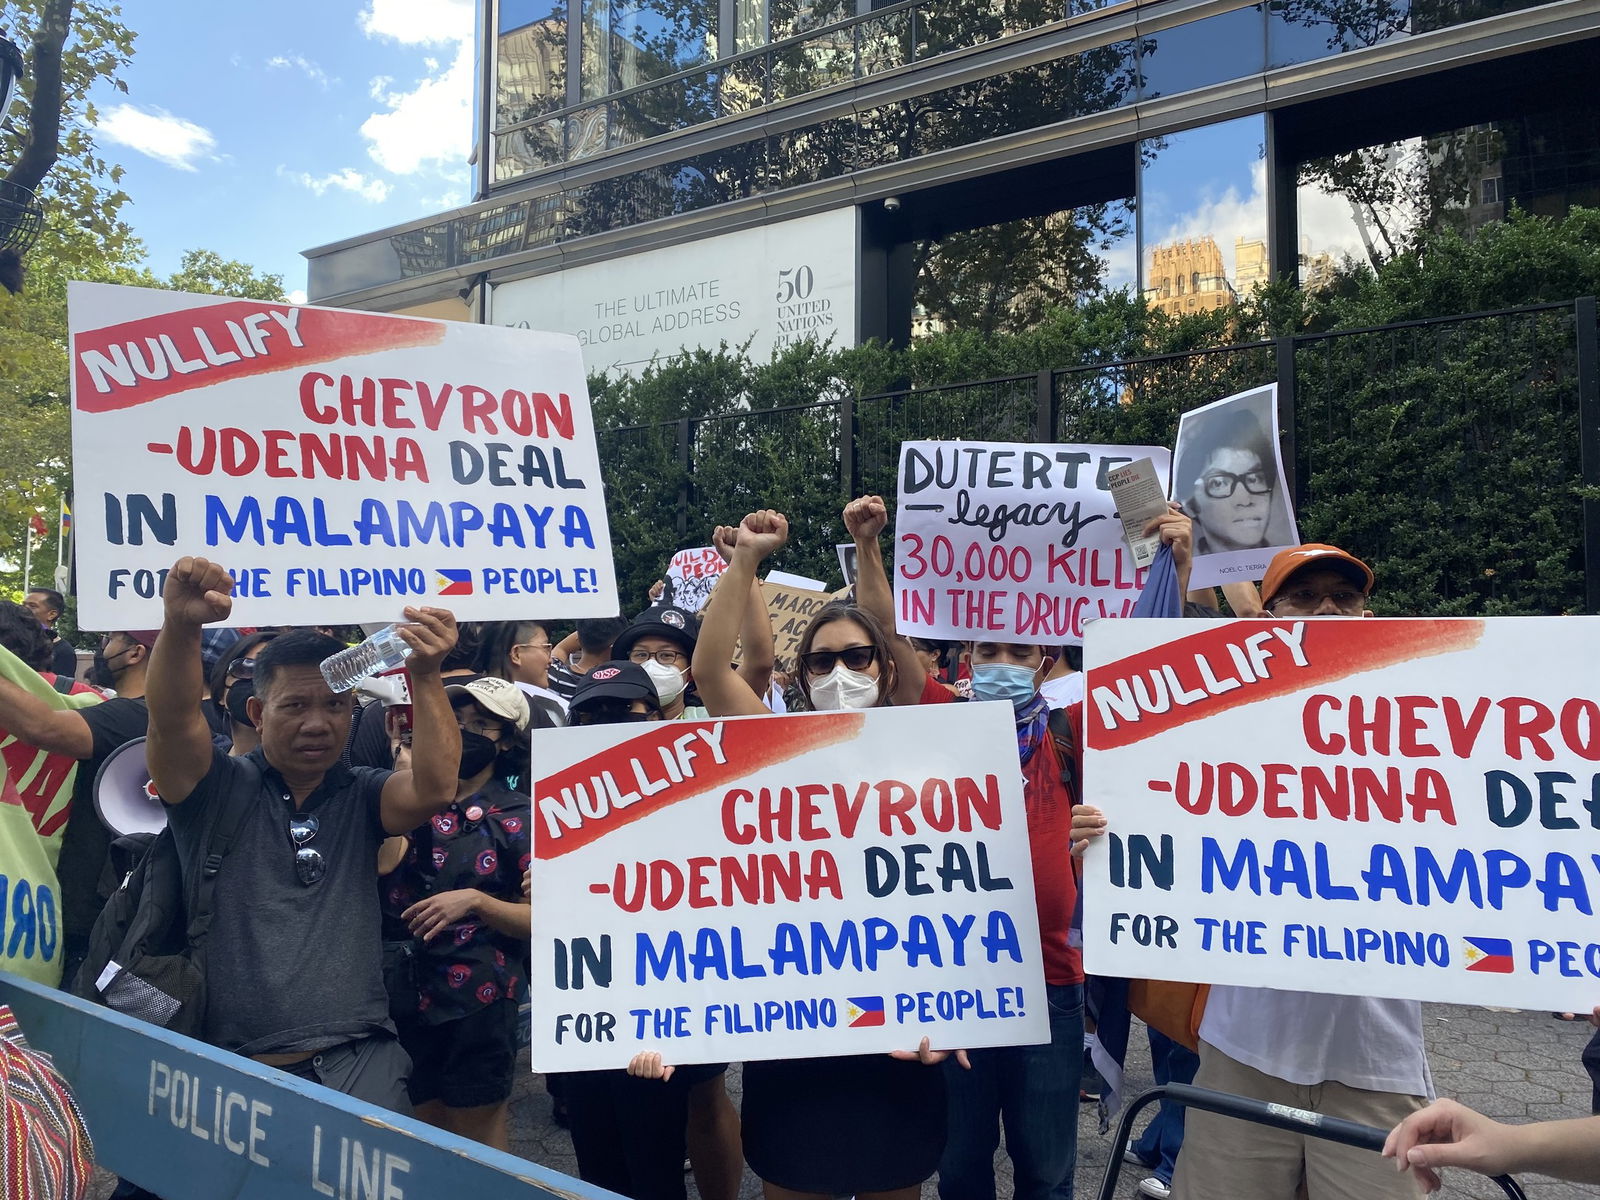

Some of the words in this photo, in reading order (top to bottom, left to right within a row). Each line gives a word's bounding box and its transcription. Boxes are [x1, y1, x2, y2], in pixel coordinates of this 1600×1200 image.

[594, 298, 627, 320] THE
[633, 279, 721, 314] ULTIMATE
[776, 264, 814, 305] 50
[777, 299, 832, 319] UNITED
[80, 307, 306, 394] NULLIFY
[577, 324, 646, 347] GLOBAL
[652, 301, 741, 335] ADDRESS
[776, 313, 834, 334] NATIONS
[299, 371, 576, 440] CHEVRON
[147, 425, 430, 483] -UDENNA
[449, 440, 587, 490] DEAL
[1110, 477, 1131, 490] PEOPLE
[104, 492, 178, 547] IN
[204, 494, 597, 549] MALAMPAYA
[948, 489, 1106, 548] legacy
[229, 569, 272, 598] HE
[286, 567, 426, 598] FILIPINO
[482, 567, 599, 595] PEOPLE!
[900, 533, 1032, 584] 30,000
[1219, 566, 1238, 575] NOEL
[901, 588, 935, 627] IN
[946, 588, 1007, 631] THE
[1091, 621, 1311, 730] NULLIFY
[1302, 694, 1600, 761] CHEVRO
[538, 721, 728, 839] NULLIFY
[721, 774, 1003, 845] CHEVRON
[1147, 761, 1458, 826] -UDENNA
[1483, 769, 1600, 830] DE
[589, 849, 844, 913] -UDENNA
[863, 840, 1014, 898] DEAL
[1108, 832, 1175, 892] IN
[1200, 836, 1600, 917] MALAMPA
[553, 934, 613, 991] IN
[634, 910, 1024, 988] MALAMPAYA
[1109, 912, 1179, 949] FOR
[1193, 917, 1268, 956] THE
[1283, 923, 1451, 968] FILIPINO
[1527, 939, 1600, 979] PEO
[555, 1011, 617, 1046] FOR
[629, 1006, 692, 1040] THE
[704, 997, 838, 1036] FILIPINO
[895, 986, 1025, 1025] PEOPLE!
[148, 1059, 274, 1169] POLICE
